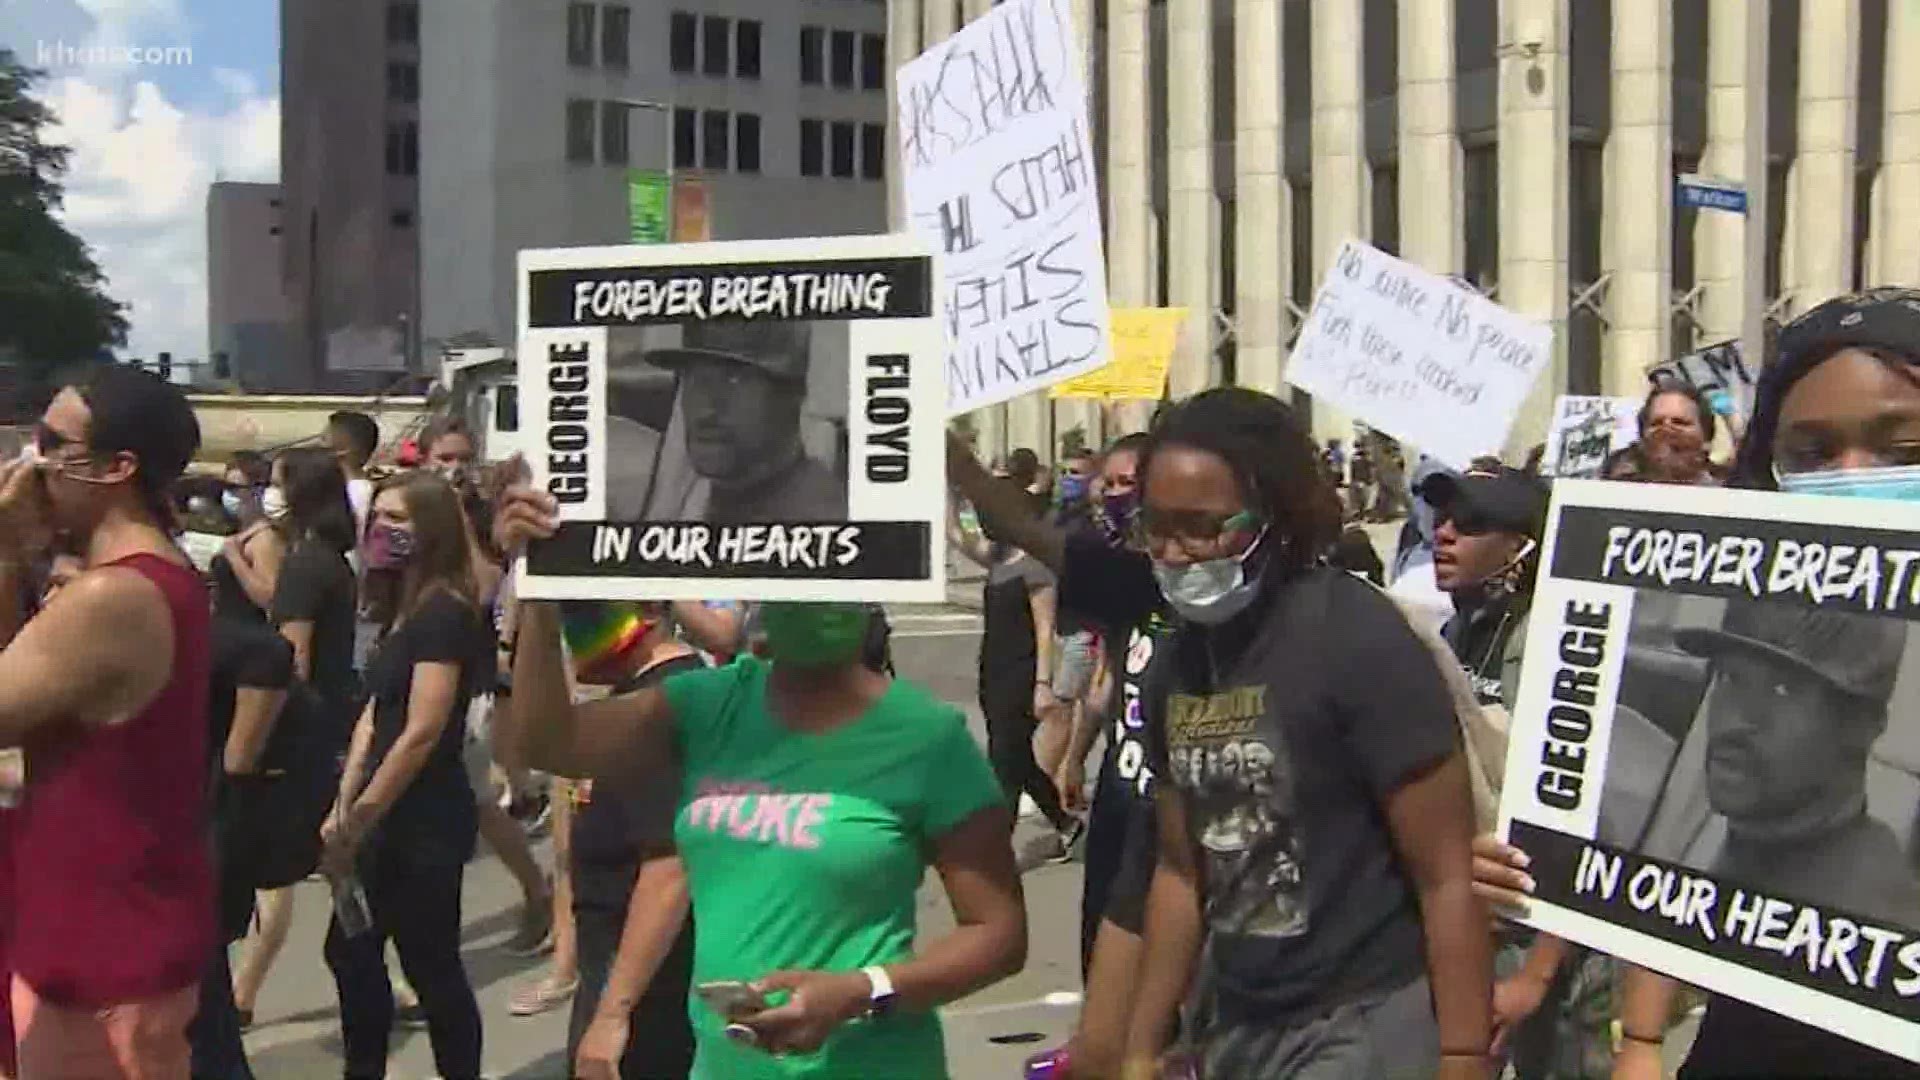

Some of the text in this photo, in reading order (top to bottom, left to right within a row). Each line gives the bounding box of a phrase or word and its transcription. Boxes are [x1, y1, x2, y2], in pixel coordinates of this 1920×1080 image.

[573, 271, 893, 322] FOREVER BREATHING
[944, 233, 1084, 337] SILEN
[1335, 242, 1364, 280] No
[1432, 293, 1471, 342] No
[944, 299, 1100, 406] STAYIN
[547, 340, 589, 504] GEORGE
[866, 353, 910, 483] FLOYD
[592, 524, 862, 569] IN OUR HEARTS
[1601, 525, 1764, 599] FOREVER
[1535, 598, 1612, 810] GEORGE
[690, 777, 834, 850] WOKE
[1574, 846, 1920, 998] IN OUR HEARTS
